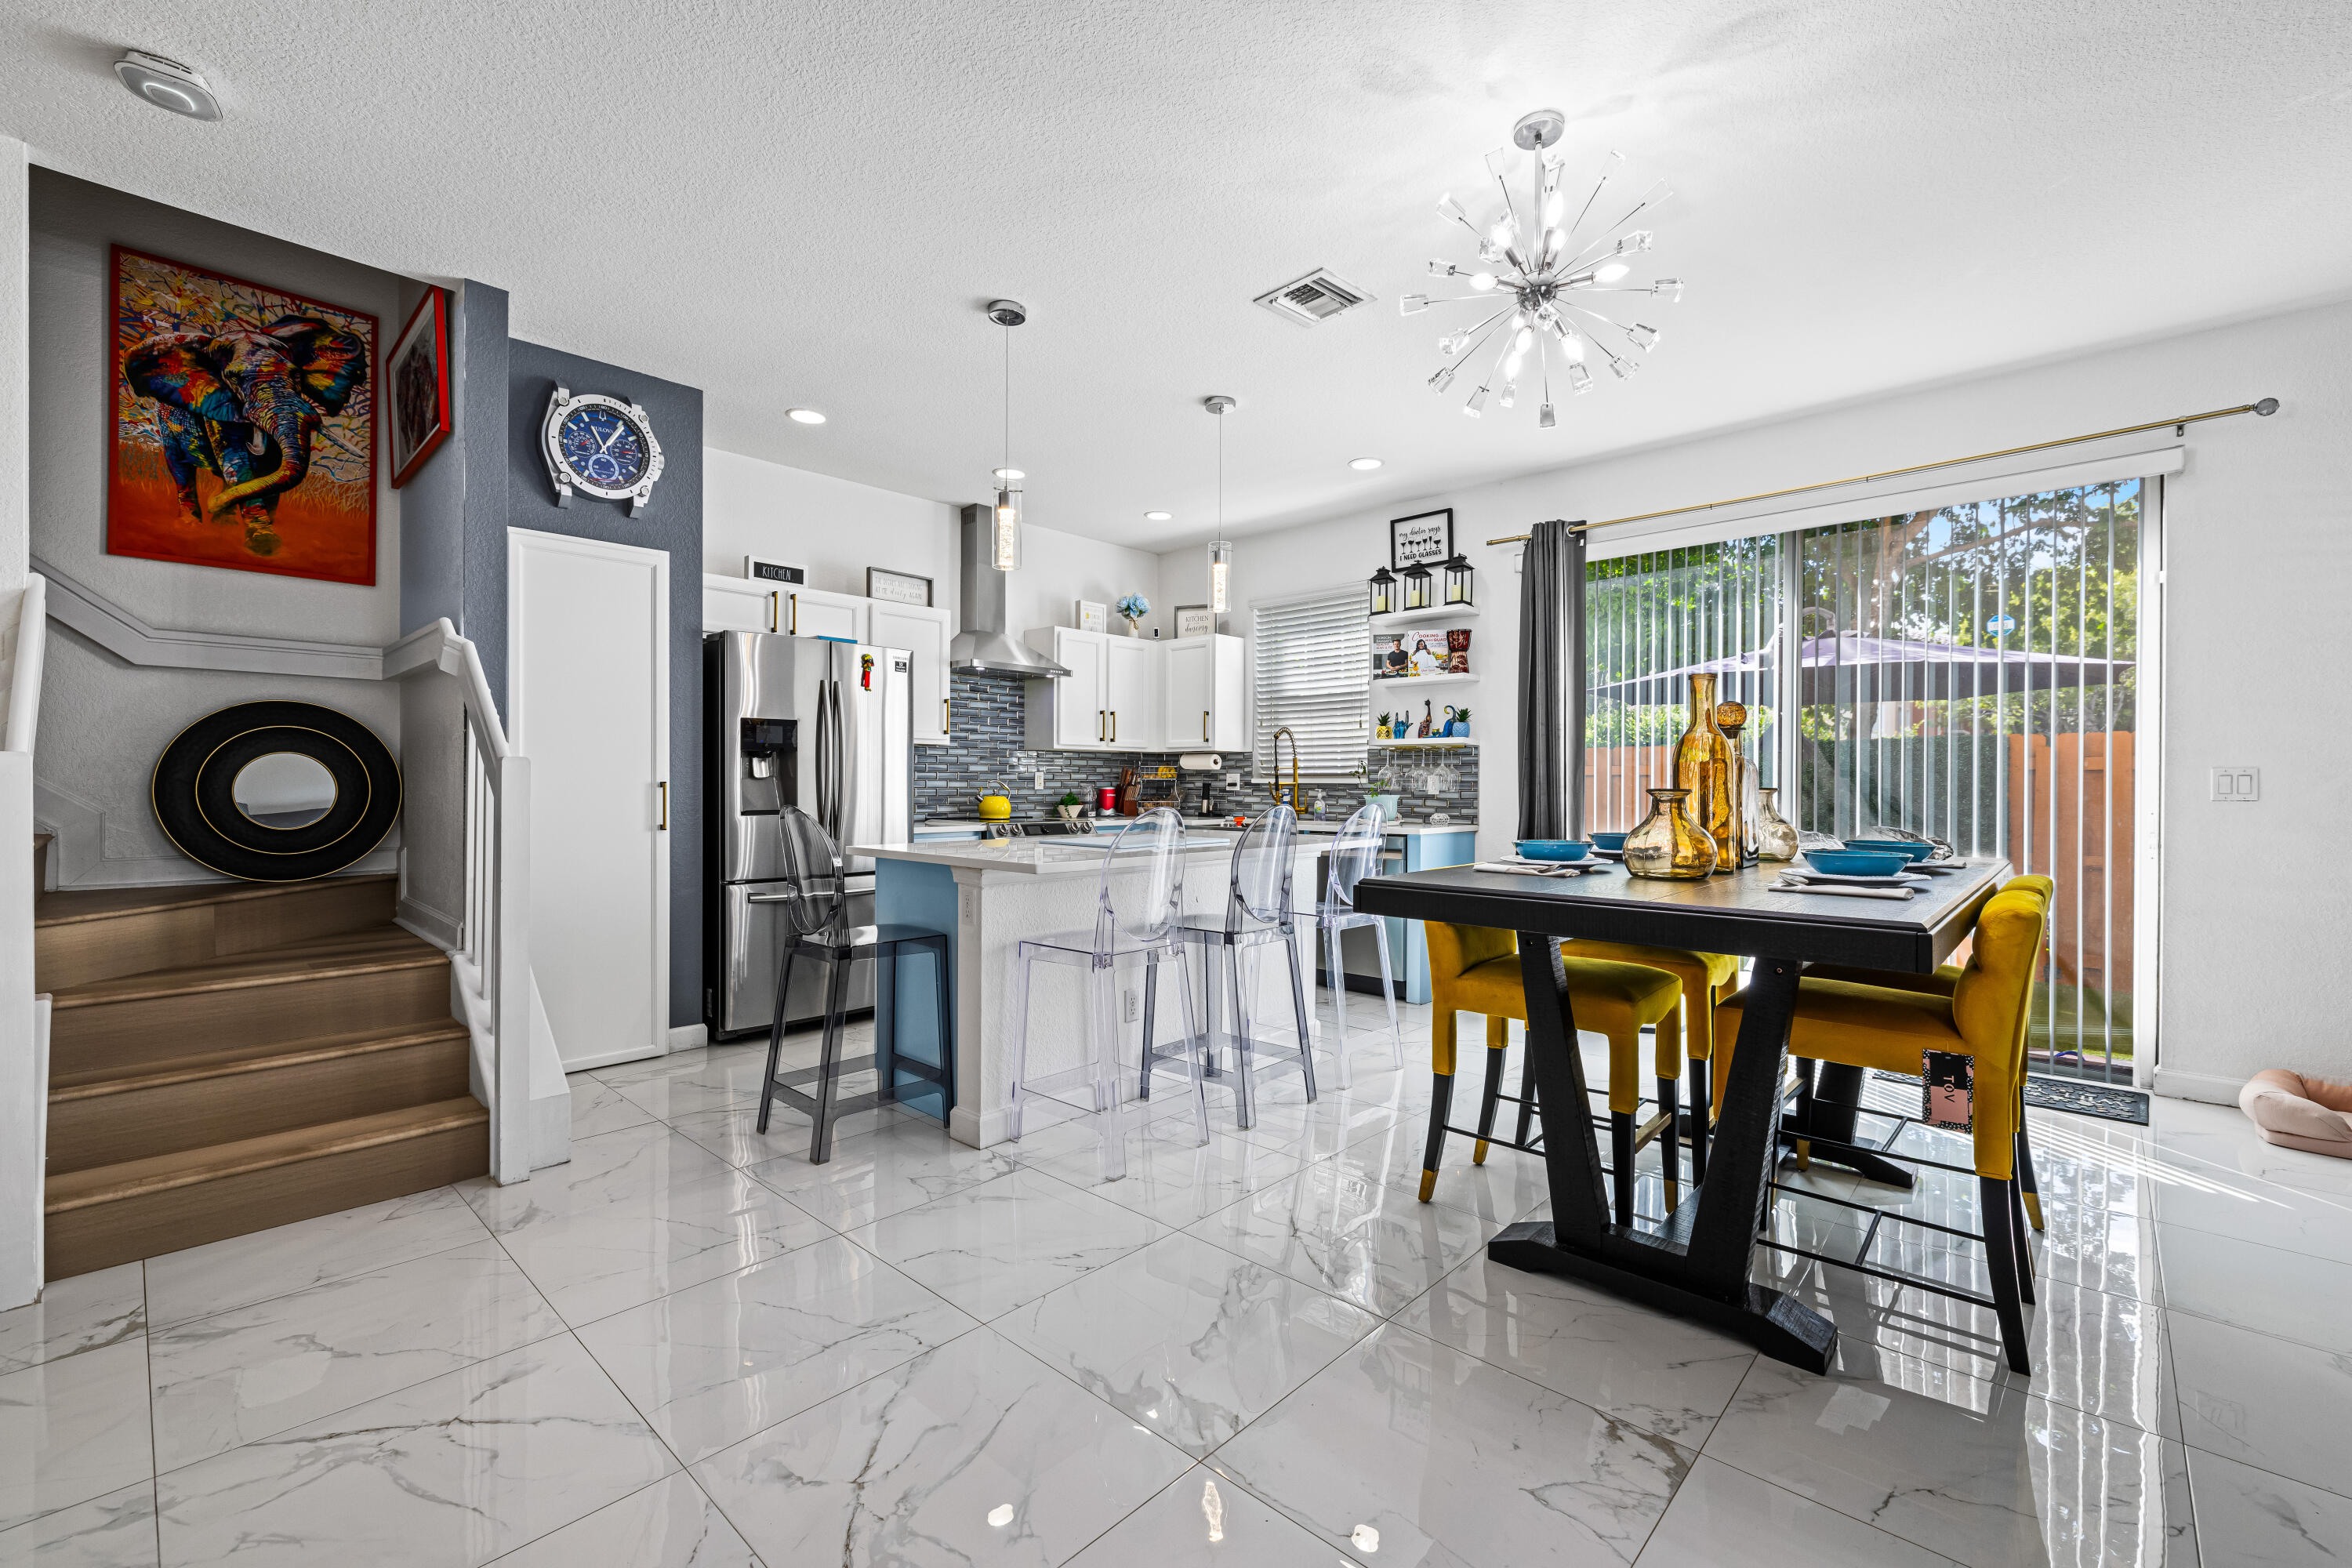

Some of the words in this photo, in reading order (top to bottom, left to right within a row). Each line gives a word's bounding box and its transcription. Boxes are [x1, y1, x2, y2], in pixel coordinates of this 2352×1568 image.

[1399, 532, 1408, 541] my
[1409, 526, 1426, 535] doctor
[1428, 525, 1441, 536] says
[1418, 549, 1442, 557] GLASSES
[762, 565, 791, 581] KITCHEN
[1412, 632, 1439, 641] COOKING
[1943, 1075, 1955, 1102] TOV
